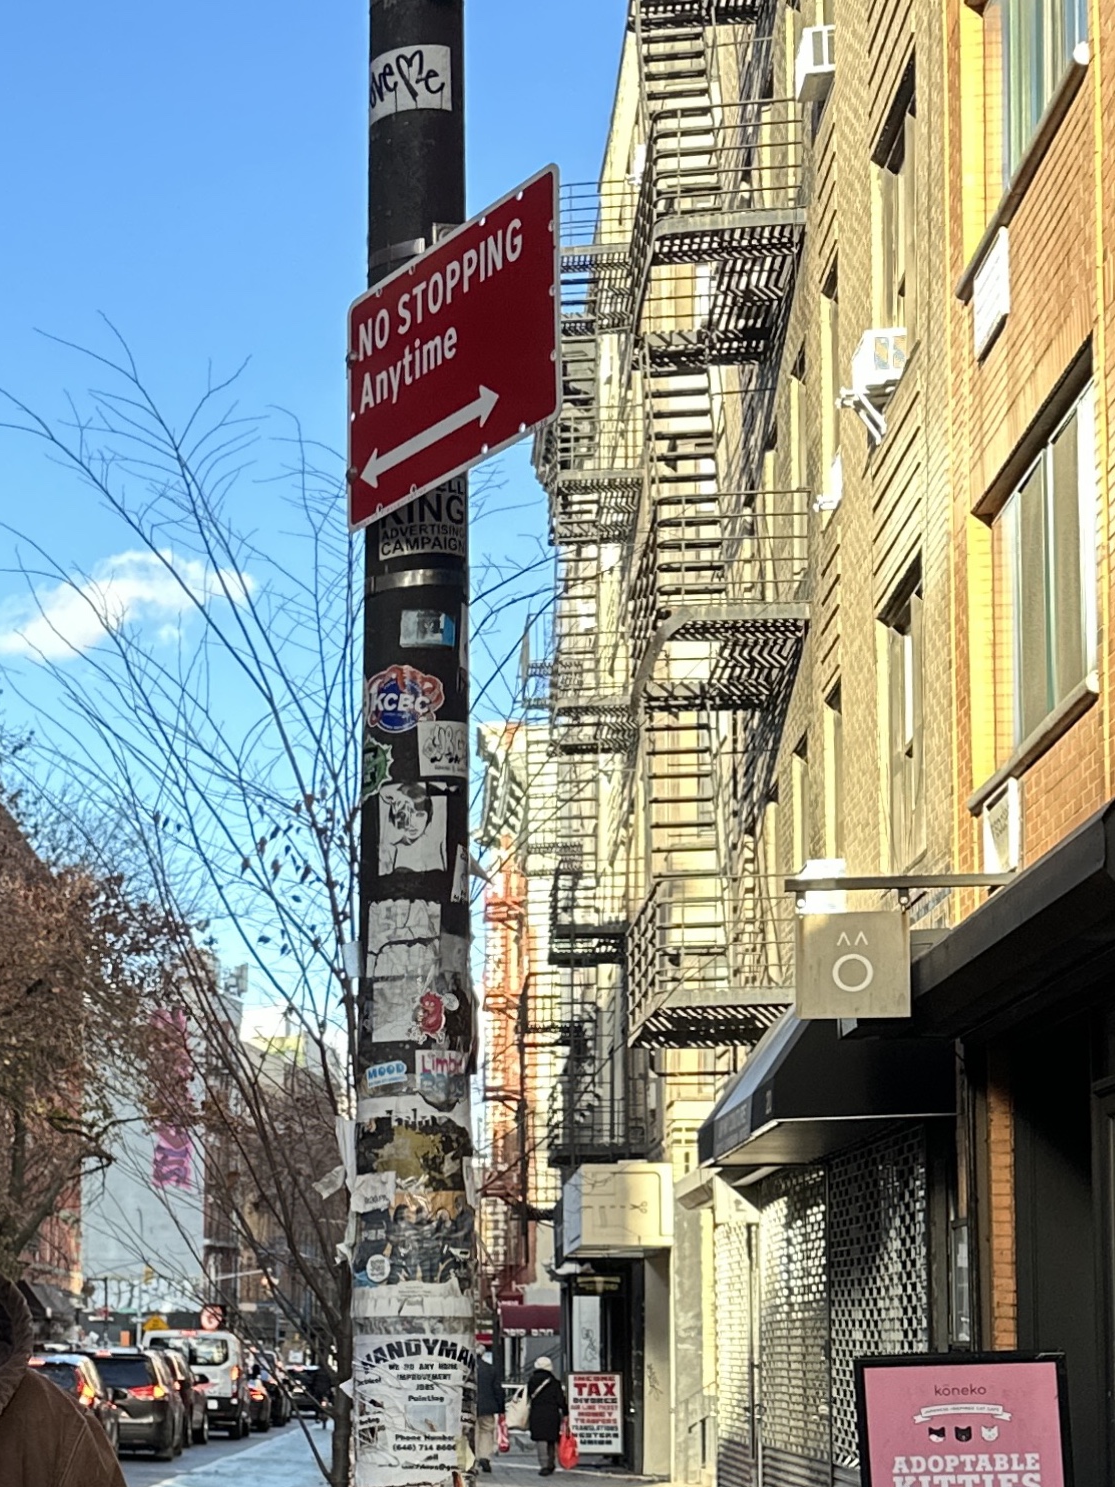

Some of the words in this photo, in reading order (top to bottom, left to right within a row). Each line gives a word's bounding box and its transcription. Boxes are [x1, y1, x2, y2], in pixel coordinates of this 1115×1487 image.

[359, 308, 389, 362] NO
[398, 218, 523, 335] STOPPING
[360, 326, 458, 415] Anytime
[382, 524, 465, 541] ADVERTISING
[381, 537, 465, 556] CAMPAIGN
[371, 693, 430, 714] KCBC
[368, 1063, 405, 1080] MOOD
[408, 1395, 445, 1403] Painting
[574, 1383, 616, 1396] TAX
[892, 1453, 1040, 1473] ADOPTABLE
